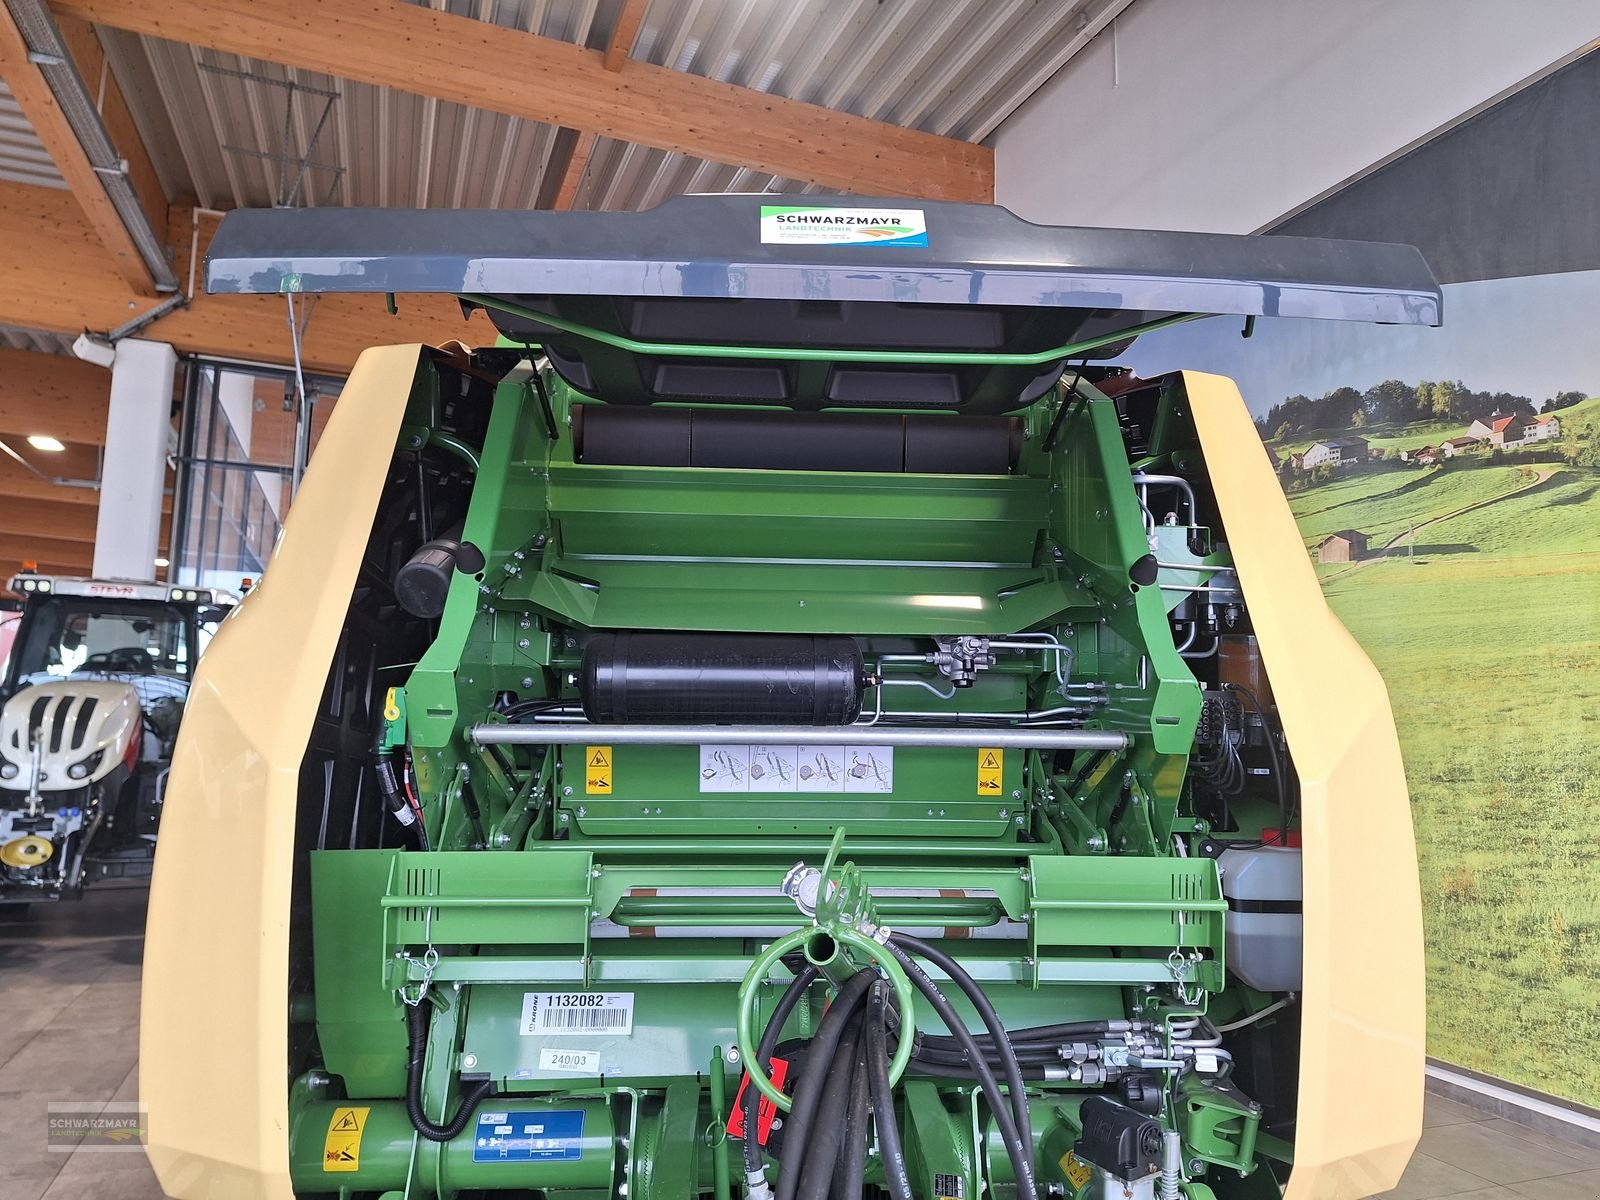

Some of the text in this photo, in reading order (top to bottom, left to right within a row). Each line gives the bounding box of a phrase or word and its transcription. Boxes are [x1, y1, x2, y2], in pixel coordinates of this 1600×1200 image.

[776, 215, 901, 226] SCHWARZMAYR
[547, 995, 604, 1007] 1132082
[551, 1054, 587, 1066] 240/03
